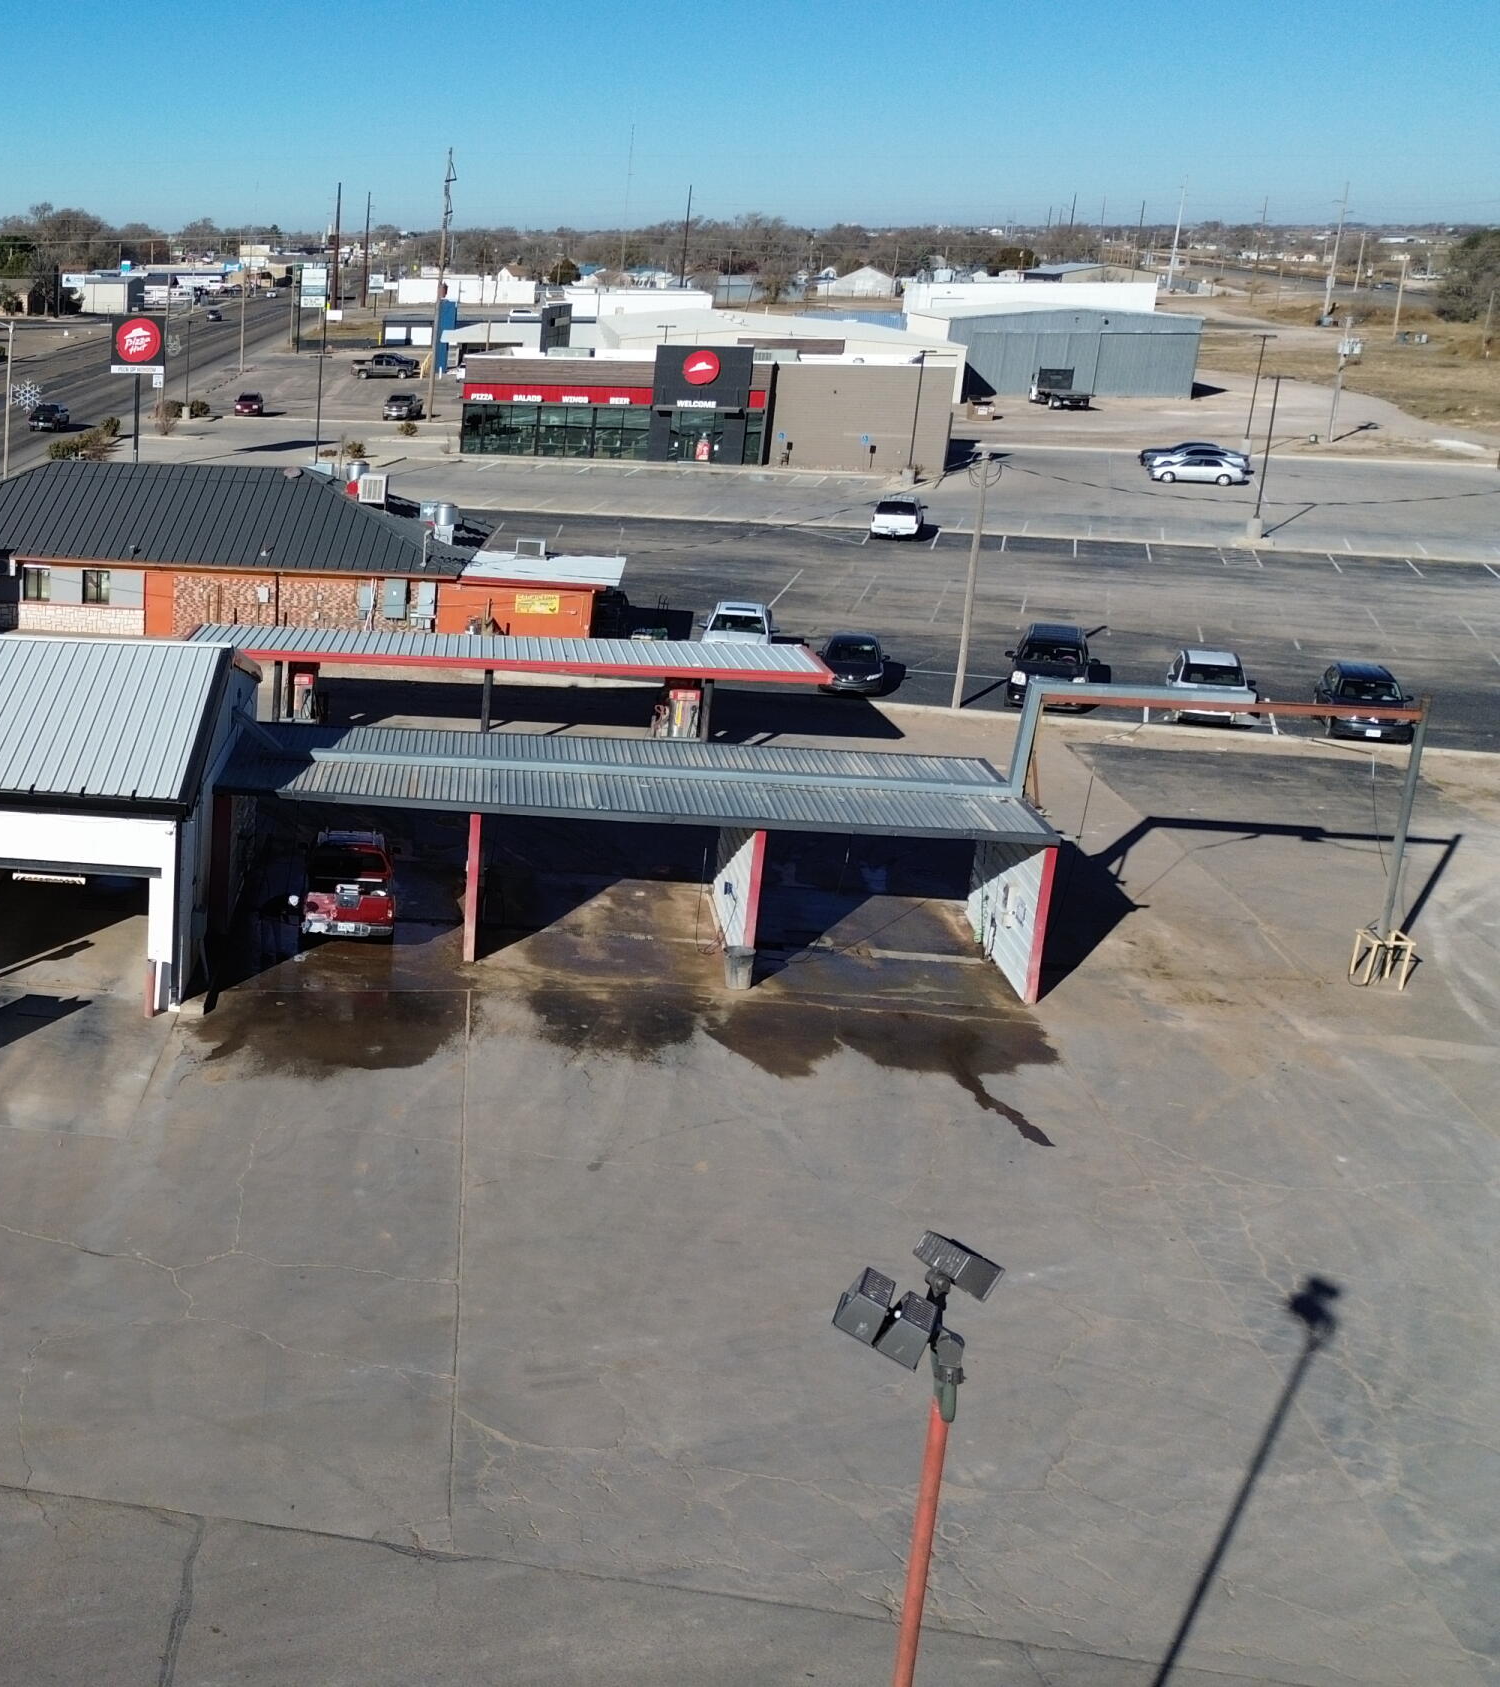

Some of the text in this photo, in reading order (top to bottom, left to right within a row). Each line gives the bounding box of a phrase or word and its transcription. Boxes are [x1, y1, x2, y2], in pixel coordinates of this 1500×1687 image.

[124, 336, 151, 350] Pizza
[129, 344, 148, 355] Hut
[471, 393, 630, 405] PIZZA SALADS WINGS BEER
[676, 400, 717, 409] WELCOME
